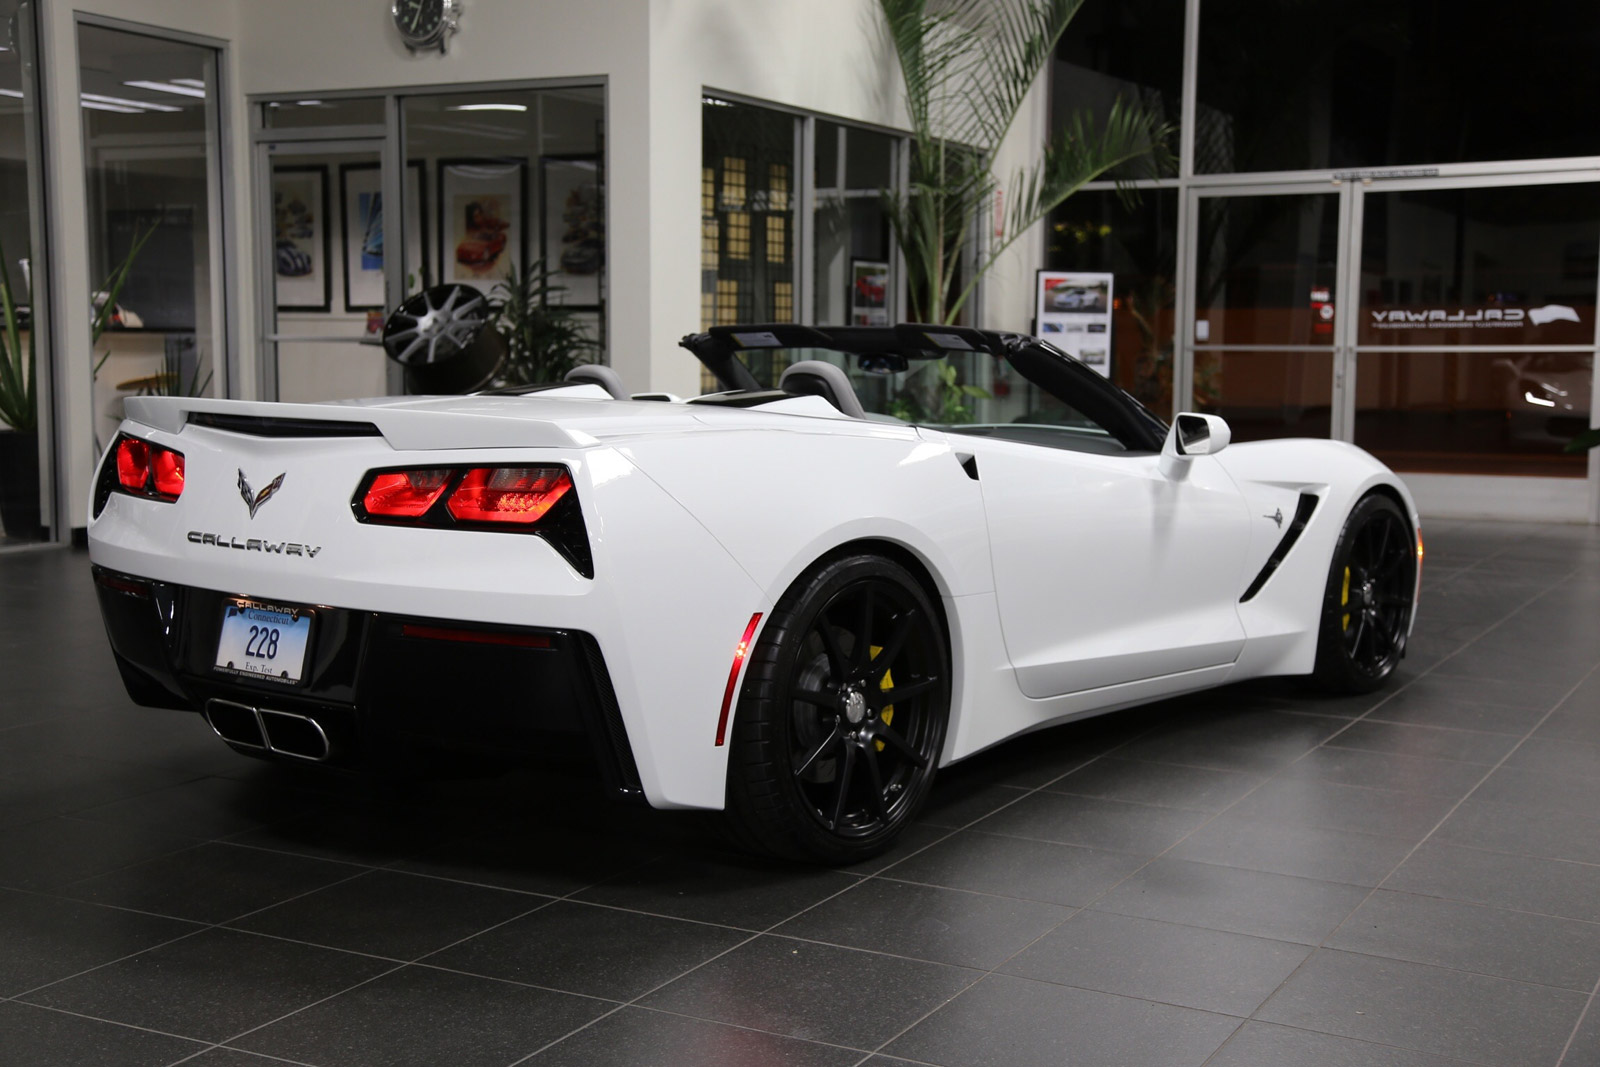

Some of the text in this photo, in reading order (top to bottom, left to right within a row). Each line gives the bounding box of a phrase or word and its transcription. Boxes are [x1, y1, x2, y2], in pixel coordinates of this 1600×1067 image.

[187, 531, 321, 558] CALLAWAY
[236, 601, 299, 615] CALLAWAY
[248, 611, 289, 625] Connecticut
[245, 625, 280, 660] 228
[245, 661, 273, 674] Exp. Test
